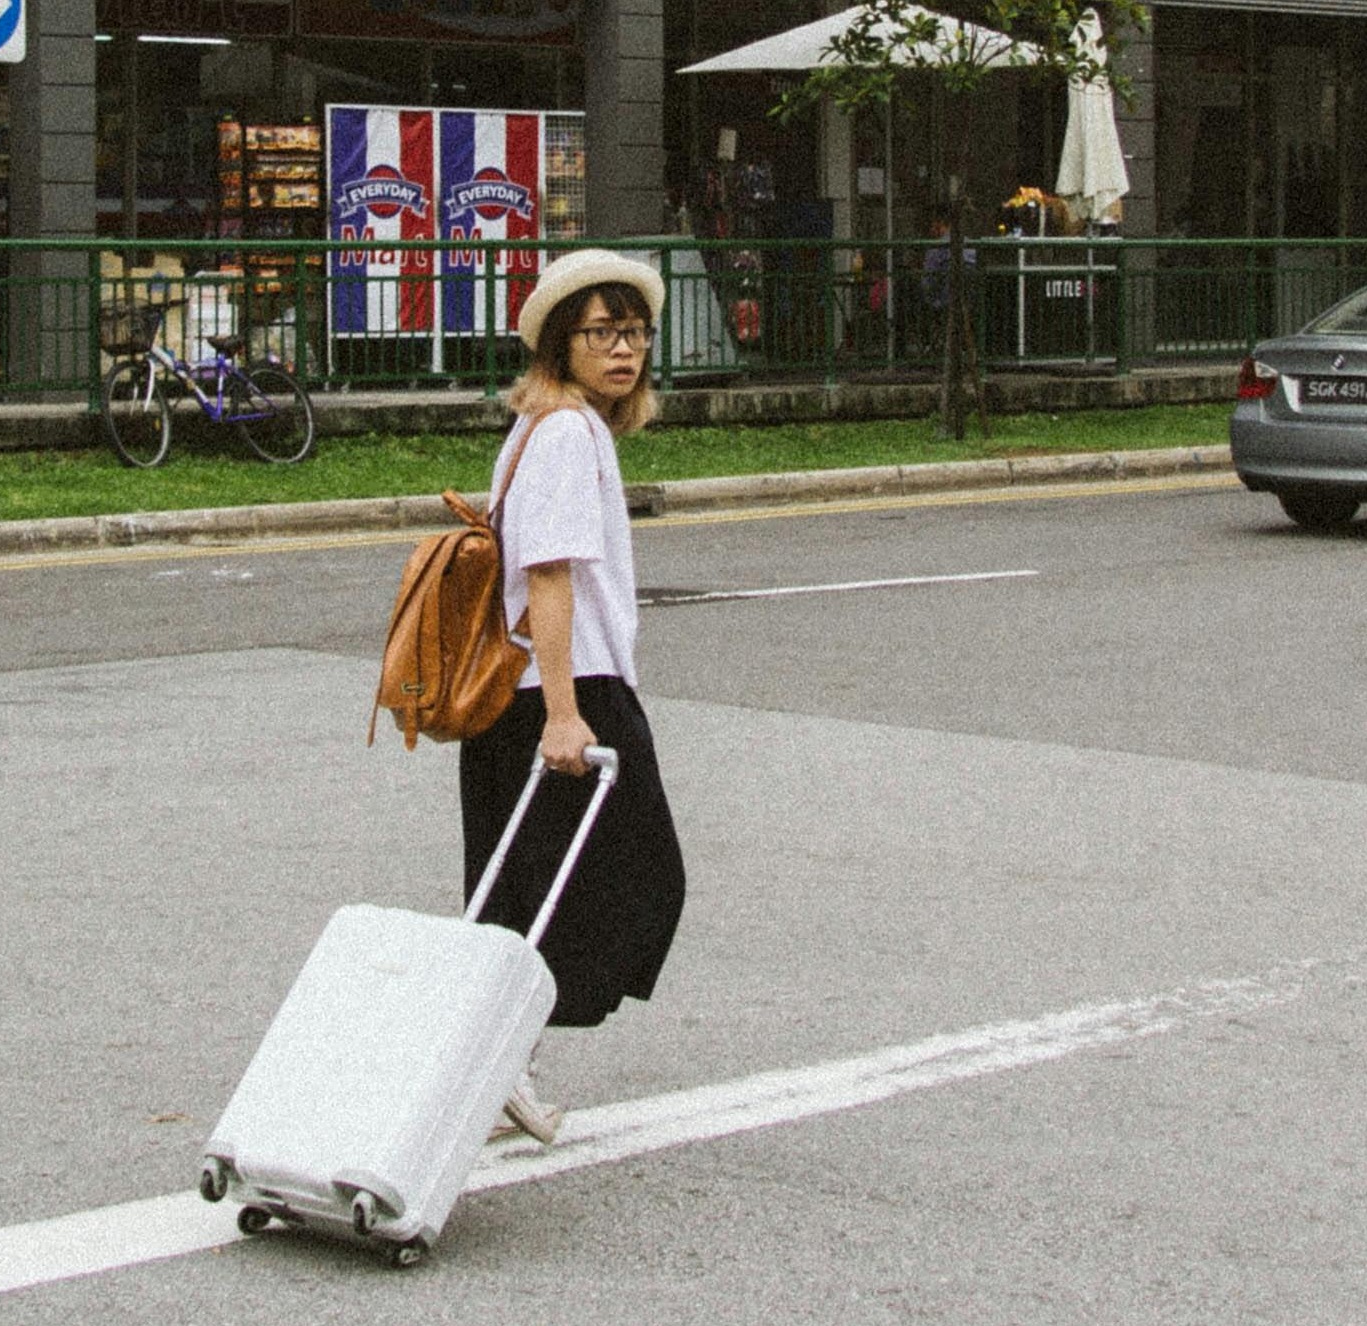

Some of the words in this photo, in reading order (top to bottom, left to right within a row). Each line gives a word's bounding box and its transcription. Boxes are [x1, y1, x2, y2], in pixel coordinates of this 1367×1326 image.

[350, 183, 417, 203] EVERYDAY
[458, 185, 523, 205] EVERYDAY
[1045, 279, 1082, 298] LITTLE
[1307, 381, 1337, 397] SGK
